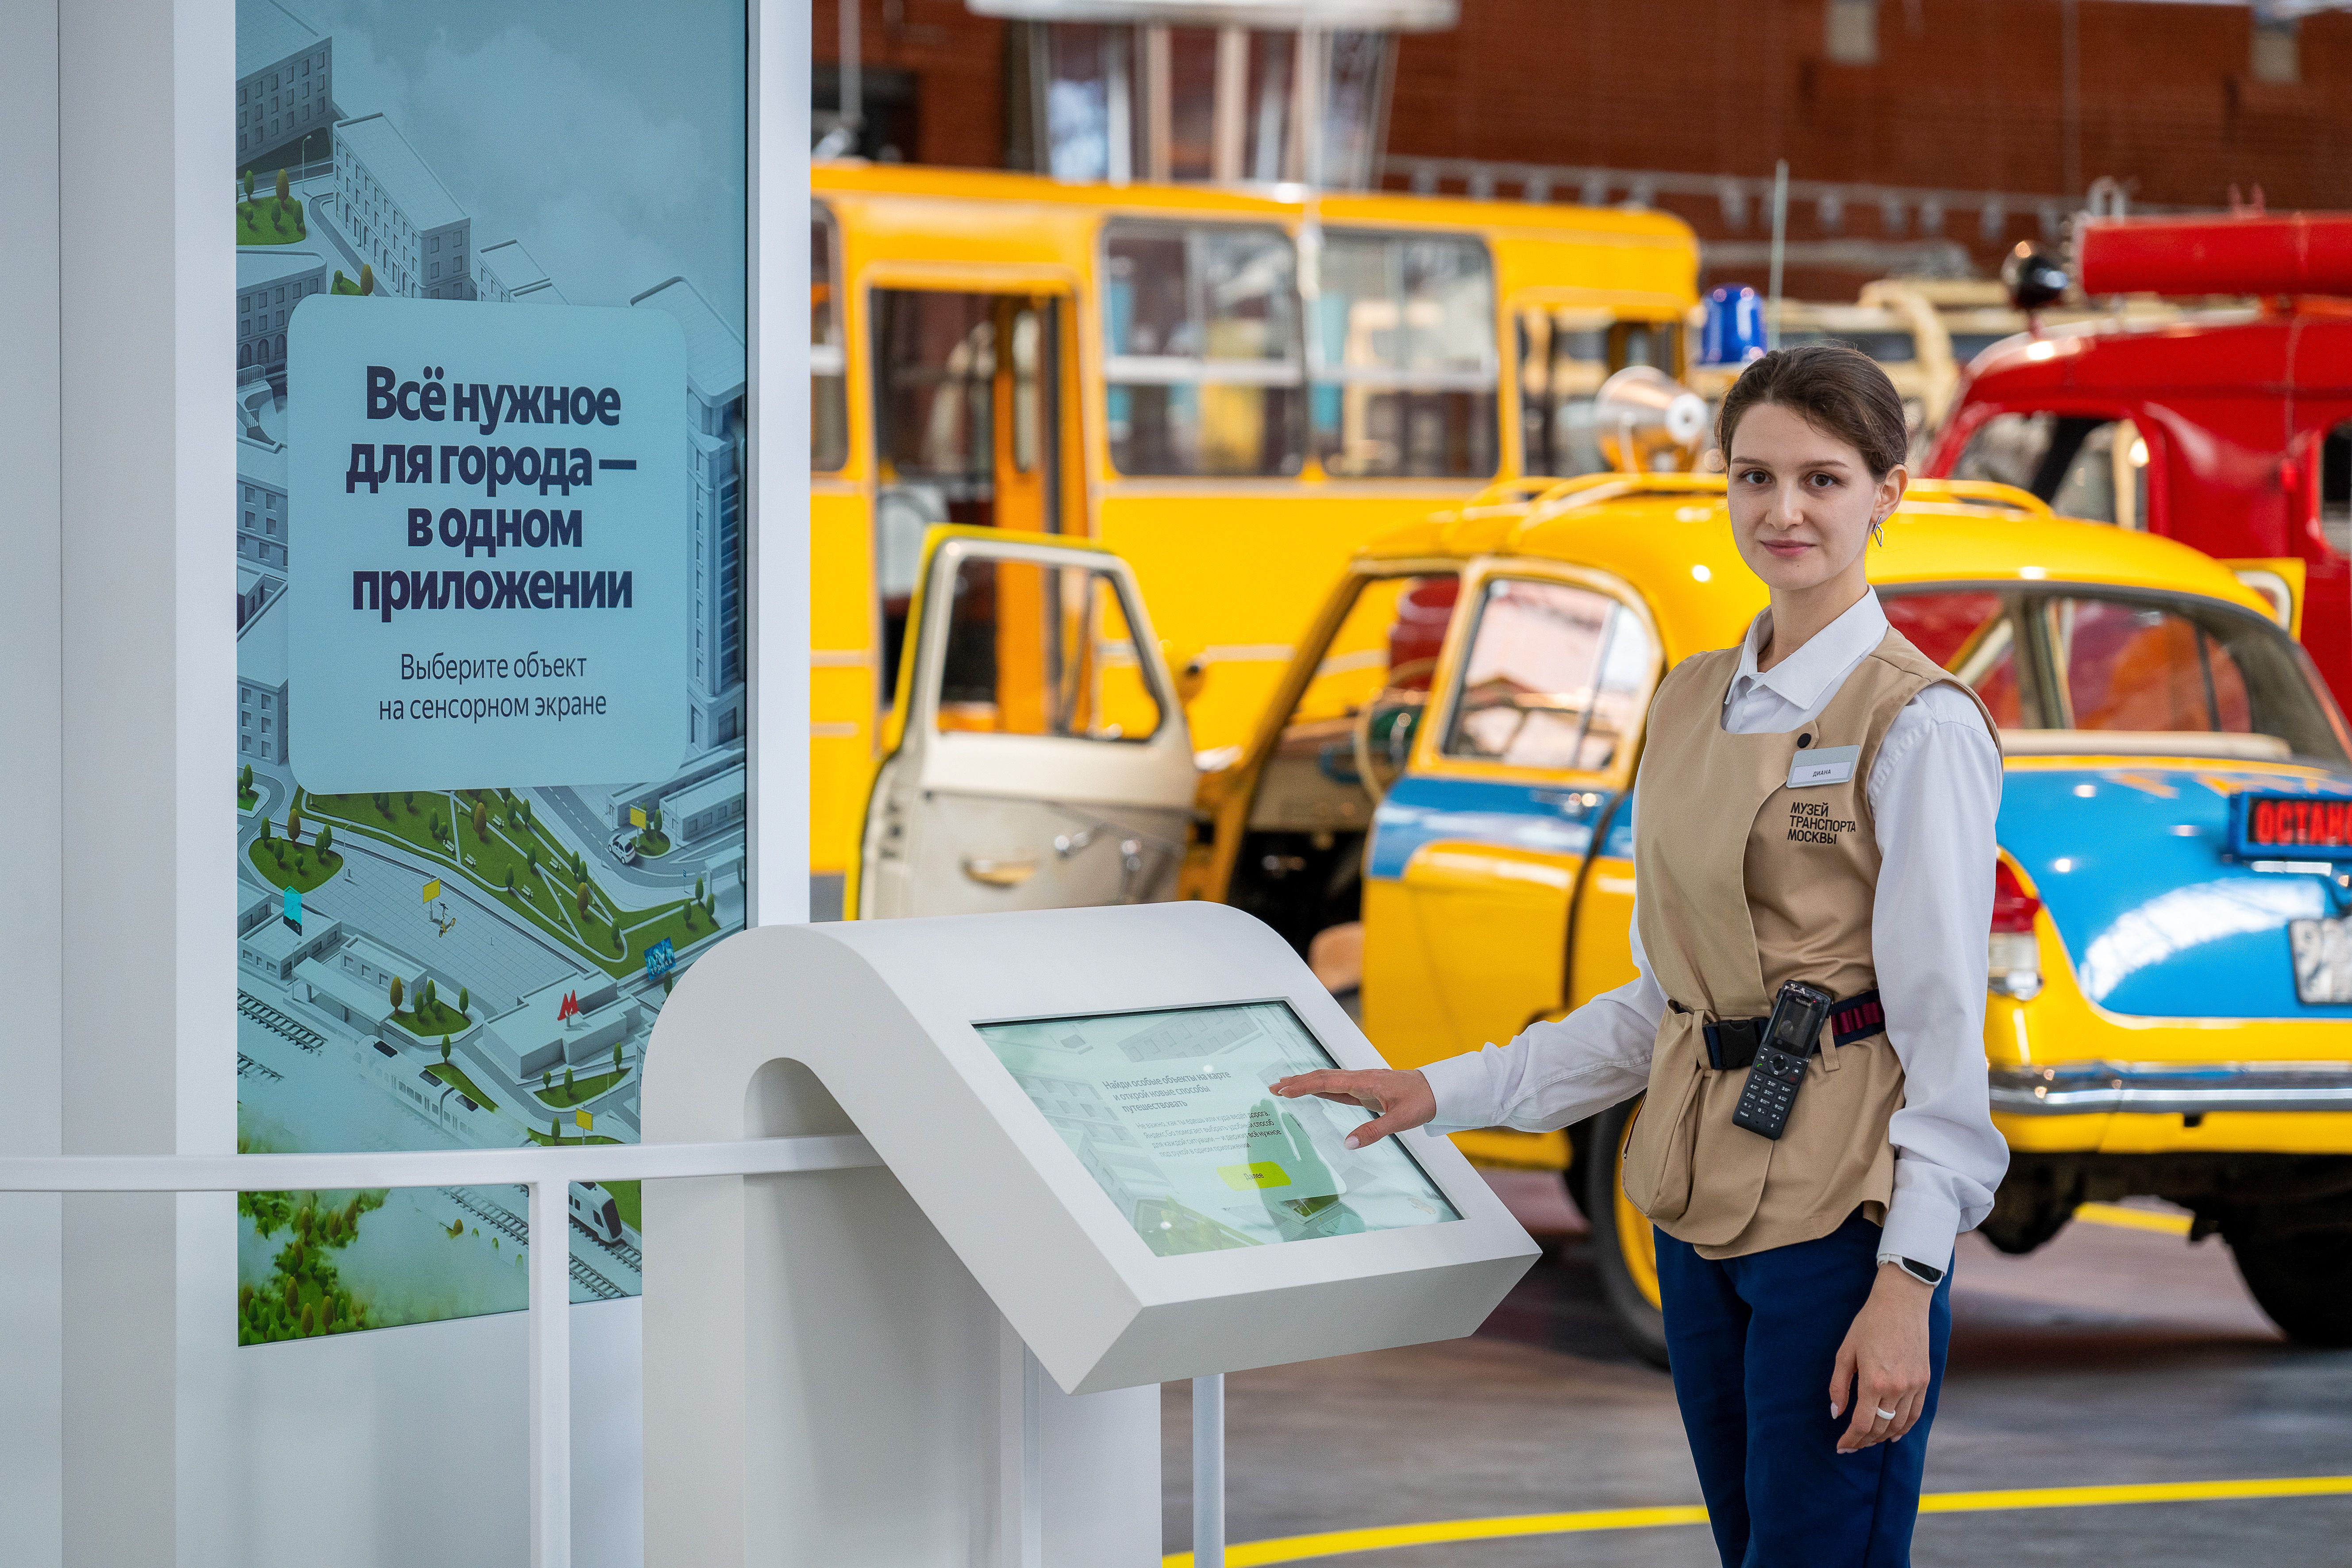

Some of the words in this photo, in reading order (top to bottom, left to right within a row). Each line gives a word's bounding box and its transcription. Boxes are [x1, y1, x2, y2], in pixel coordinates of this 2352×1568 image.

[367, 365, 446, 422] Всё
[453, 382, 621, 435] нужное
[346, 443, 432, 493] для
[440, 444, 592, 497] города
[408, 508, 432, 547] в
[439, 508, 582, 557] одном
[353, 570, 632, 622] приложении
[401, 651, 508, 685] Выберите
[514, 651, 587, 678] объект
[380, 699, 403, 719] на
[410, 697, 528, 724] сенсорном
[535, 695, 606, 721] экране
[1790, 801, 1829, 817] МУЗЕЙ
[1790, 815, 1856, 832] ТРАНСПОРТА
[1787, 828, 1837, 844] МОСКВЫ
[1796, 997, 1811, 1007] Yealink
[1102, 1080, 1131, 1090] Найди
[1132, 1078, 1163, 1087] особые
[1162, 1075, 1197, 1085] объекты
[1208, 1071, 1231, 1080] карте
[1120, 1090, 1150, 1101] открой
[1149, 1089, 1176, 1098] новые
[1176, 1085, 1211, 1095] способы
[1122, 1100, 1188, 1113] путешествовать
[1228, 1122, 1254, 1131] удобный
[1259, 1129, 1282, 1138] нужное
[1213, 1143, 1251, 1152] приложении
